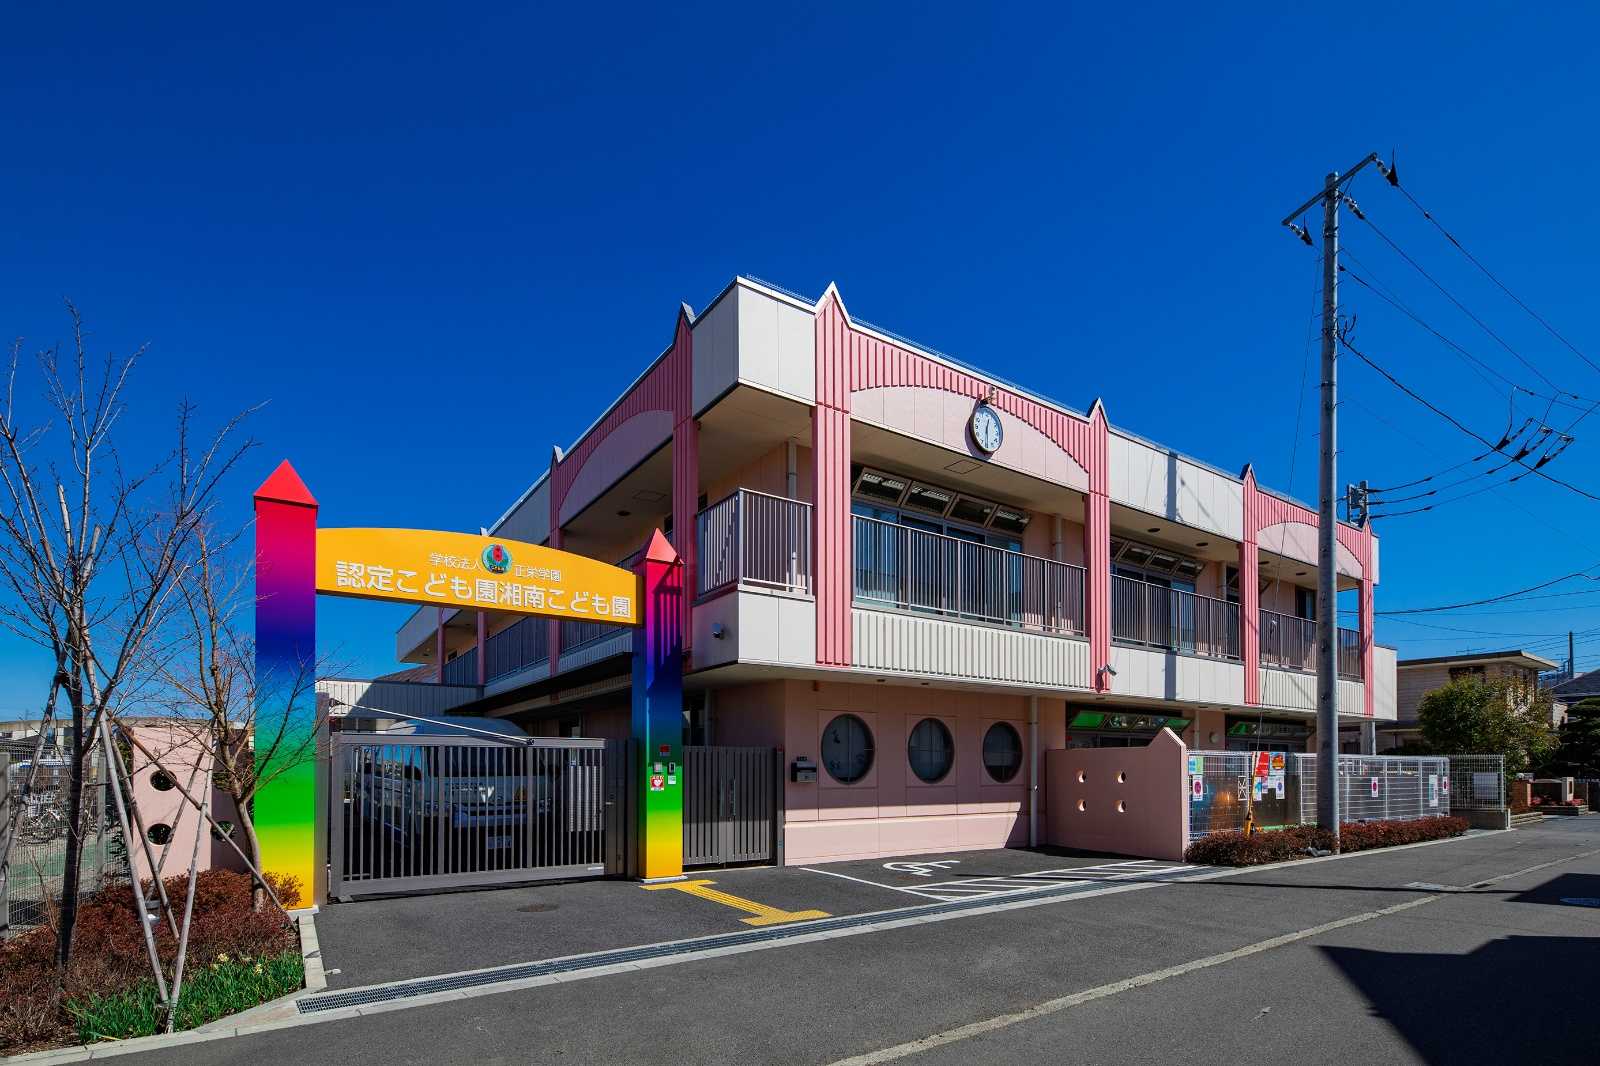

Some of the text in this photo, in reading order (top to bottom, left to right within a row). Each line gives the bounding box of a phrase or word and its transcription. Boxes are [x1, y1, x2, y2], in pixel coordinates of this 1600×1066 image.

[430, 552, 482, 571] 学校法人
[335, 560, 631, 618] 認定こども園湘南こども園
